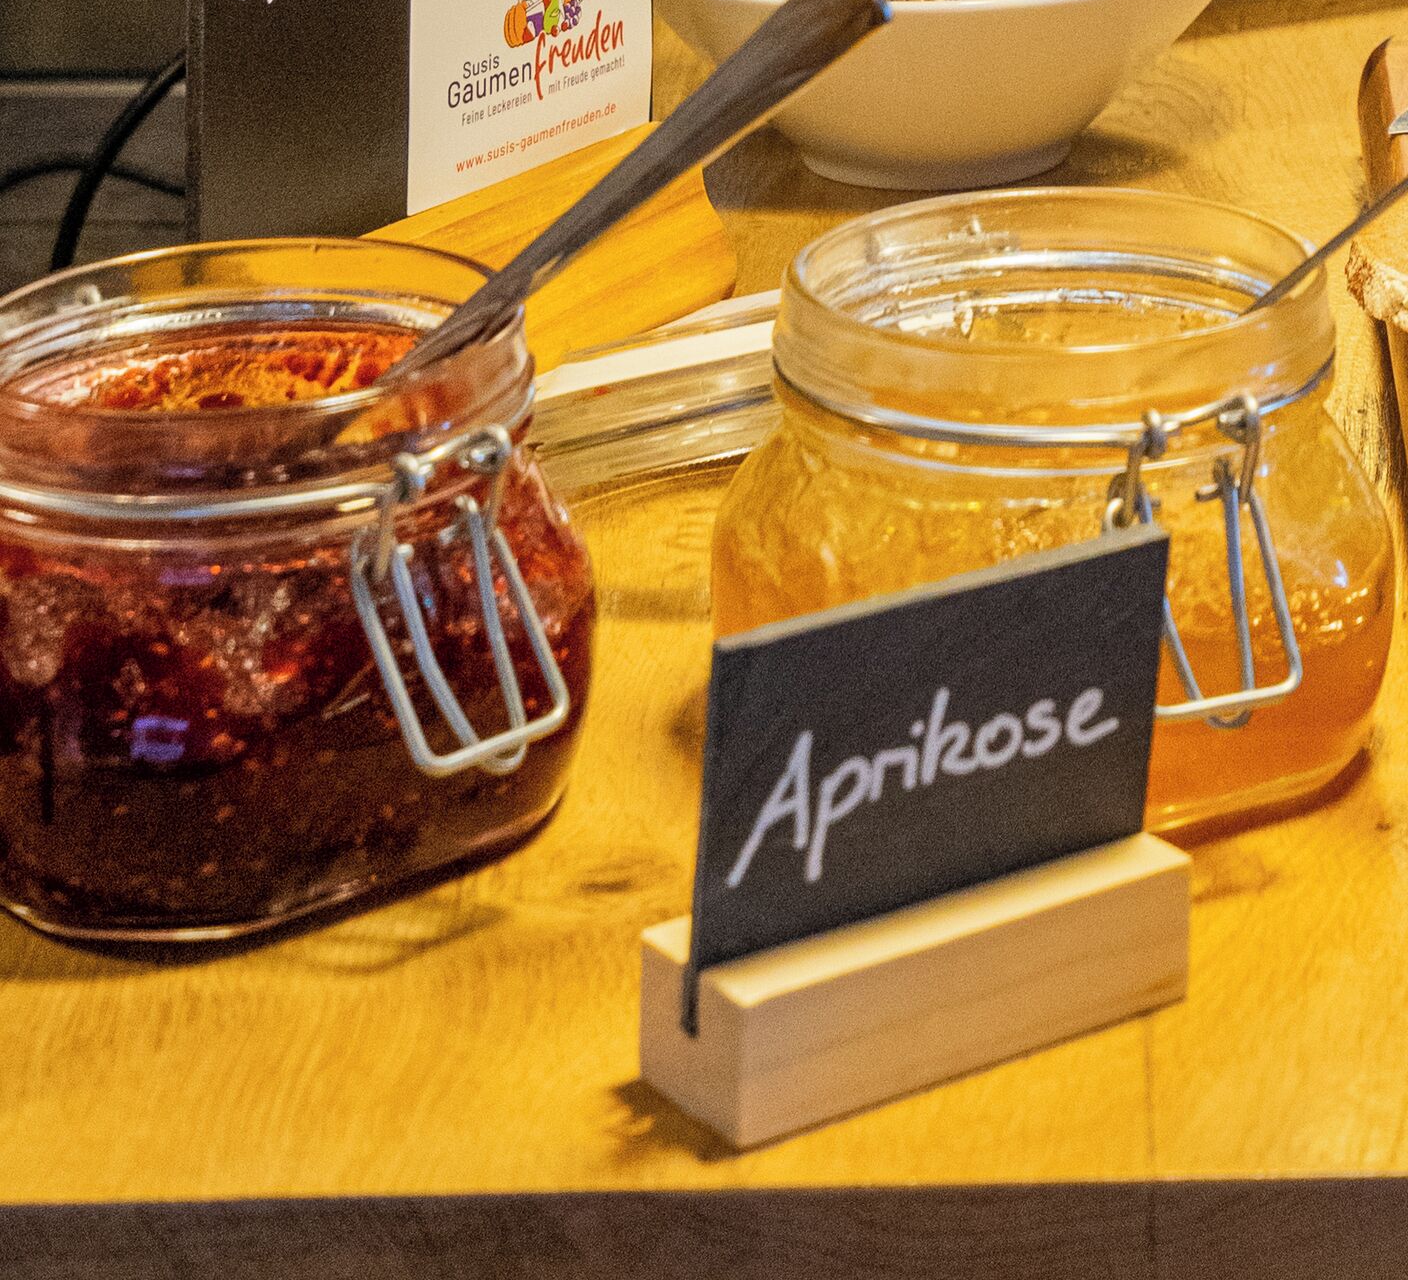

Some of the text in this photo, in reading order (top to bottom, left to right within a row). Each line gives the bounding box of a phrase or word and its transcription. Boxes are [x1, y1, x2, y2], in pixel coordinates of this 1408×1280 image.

[461, 54, 625, 126] Feine Leckereien mit Freude gemacht!
[462, 53, 500, 79] Susis
[455, 102, 617, 173] www.susis-gaumenfreuden.de
[725, 687, 1120, 888] Aprikose
